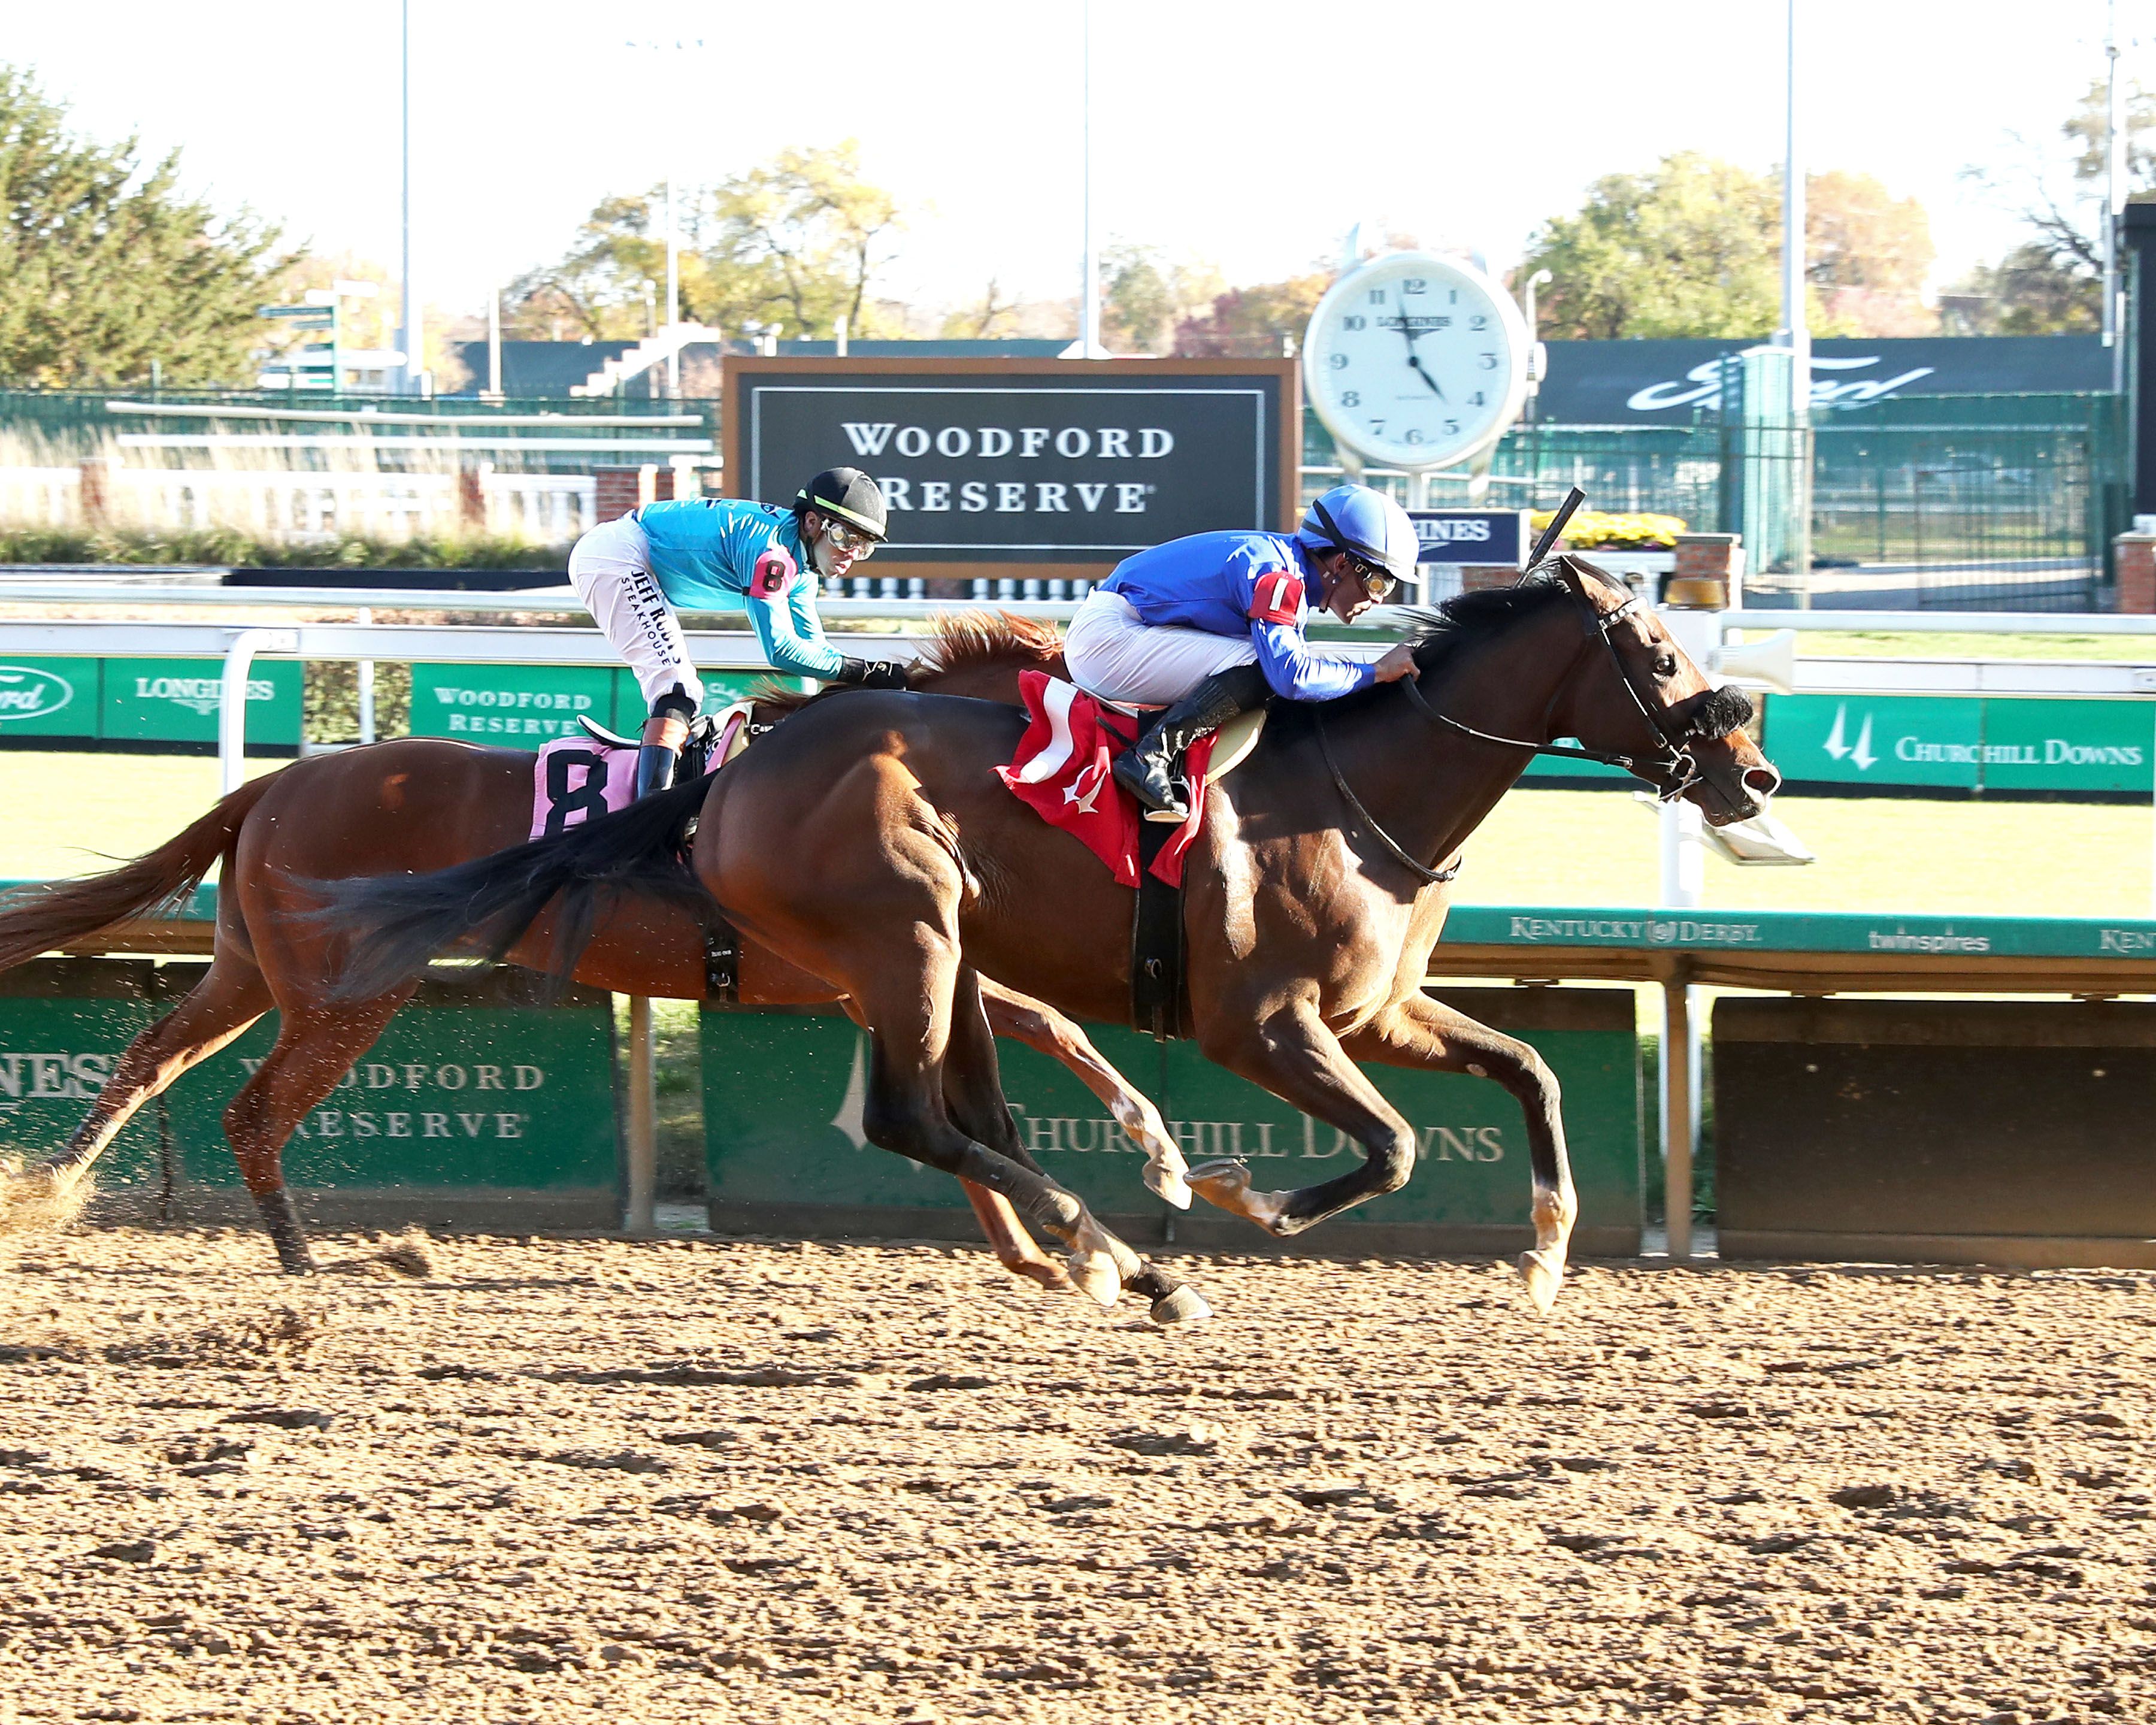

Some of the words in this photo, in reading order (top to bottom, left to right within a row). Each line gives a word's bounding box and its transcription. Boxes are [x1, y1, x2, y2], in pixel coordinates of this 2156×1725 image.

[1403, 279, 1427, 295] 12
[1369, 289, 1385, 305] 11
[1448, 289, 1457, 305] 1
[1343, 316, 1367, 331] 10
[1469, 316, 1486, 331] 2
[1330, 353, 1349, 370] 9
[1477, 353, 1498, 370] 3
[1341, 391, 1361, 407] 8
[1466, 391, 1485, 407] 4
[1369, 419, 1386, 435] 7
[1442, 419, 1460, 435] 5
[841, 422, 1175, 458] WOODFORD
[1405, 429, 1424, 445] 6
[763, 560, 786, 592] 8
[631, 571, 659, 604] JEFF
[1269, 577, 1289, 611] 1
[622, 577, 671, 665] STEAKHOUSE
[135, 677, 275, 700] LONGIES
[433, 688, 592, 710] WOODFORD
[448, 713, 578, 736] RESERVE
[1895, 736, 2040, 764] CHURCHILL
[2045, 739, 2143, 765] DOWNS
[546, 749, 608, 837] 8
[1510, 916, 1642, 940] KENTUCKY
[1679, 921, 1763, 944] DERBY
[1005, 1103, 1289, 1158] HURHILL
